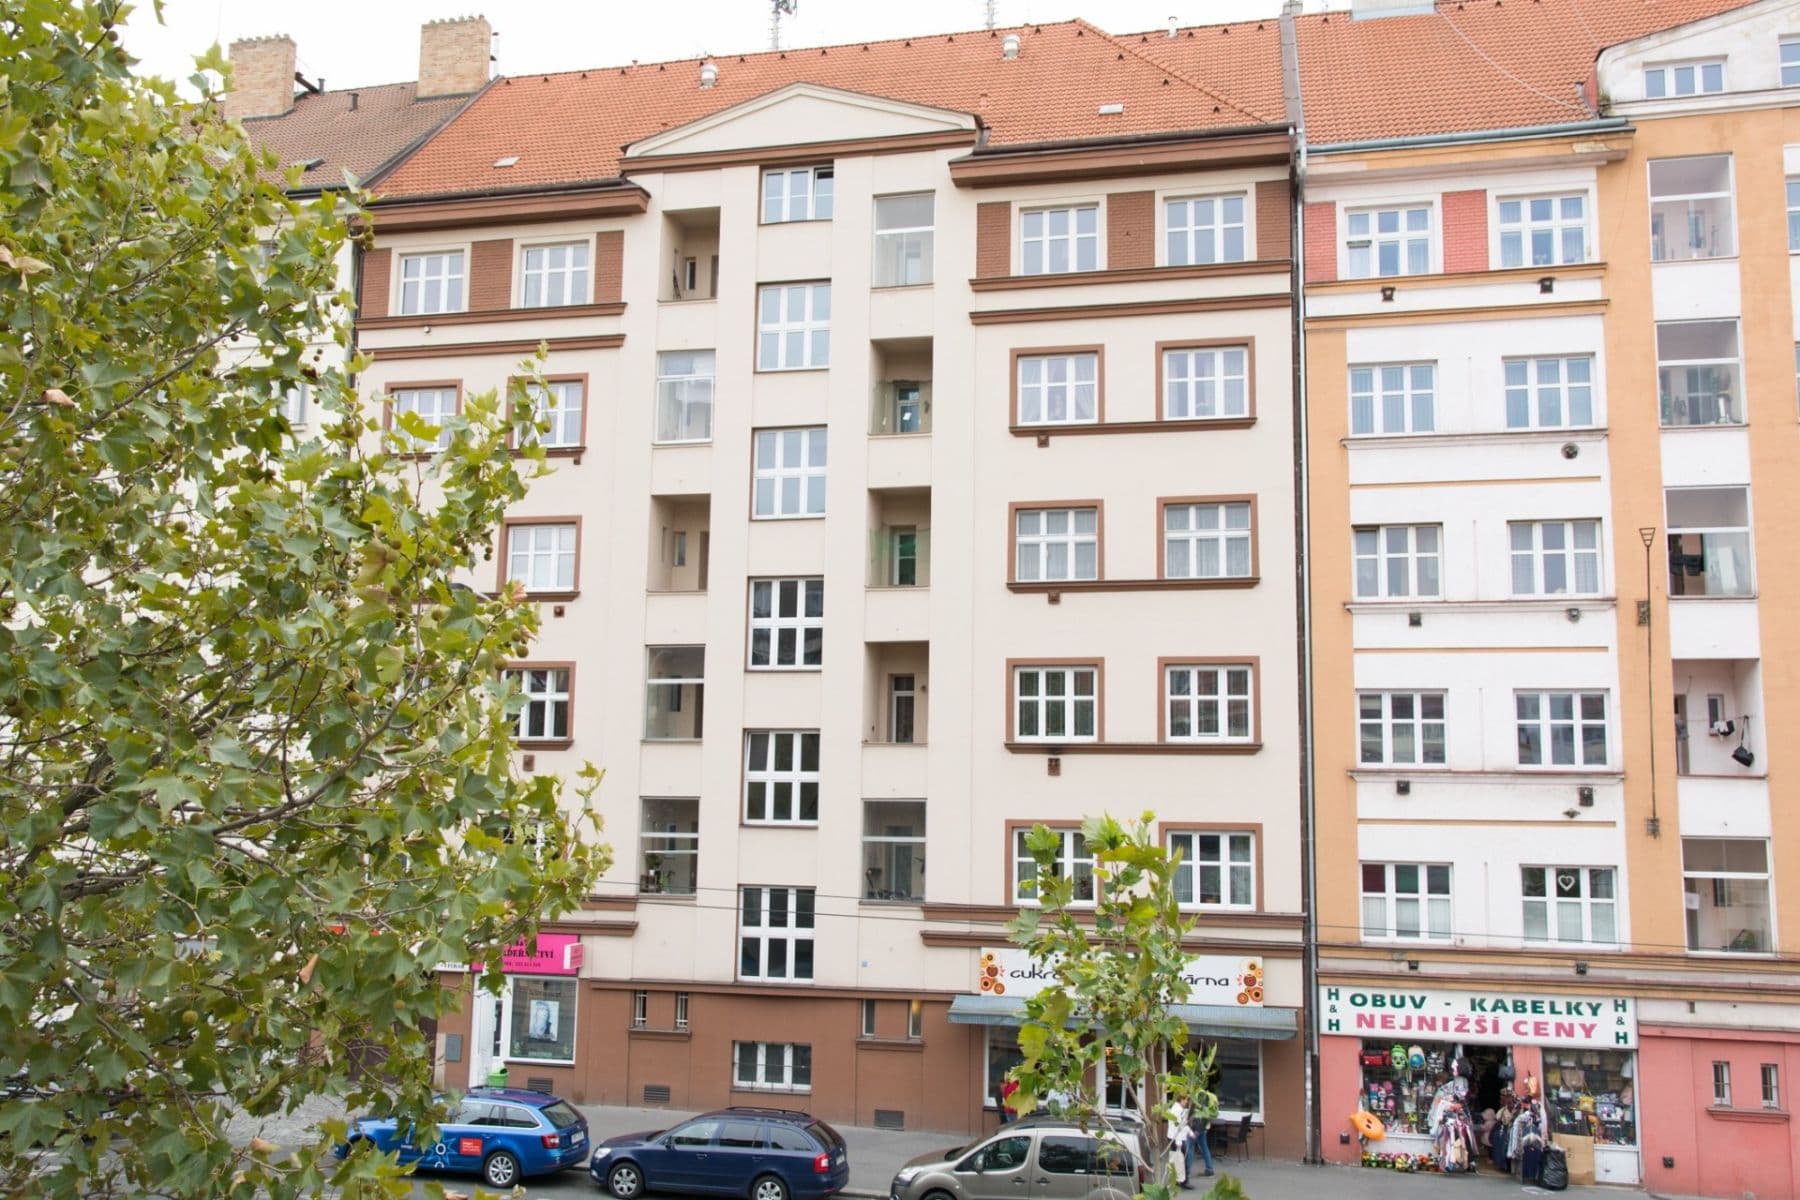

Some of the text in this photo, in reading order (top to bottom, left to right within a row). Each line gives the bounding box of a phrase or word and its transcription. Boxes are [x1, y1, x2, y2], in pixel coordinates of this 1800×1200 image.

[1179, 974, 1229, 986] árna
[1349, 993, 1427, 1009] OBUV
[1470, 998, 1602, 1016] KABELKY
[1356, 1013, 1597, 1039] NEJNIŽŠÍ CENY
